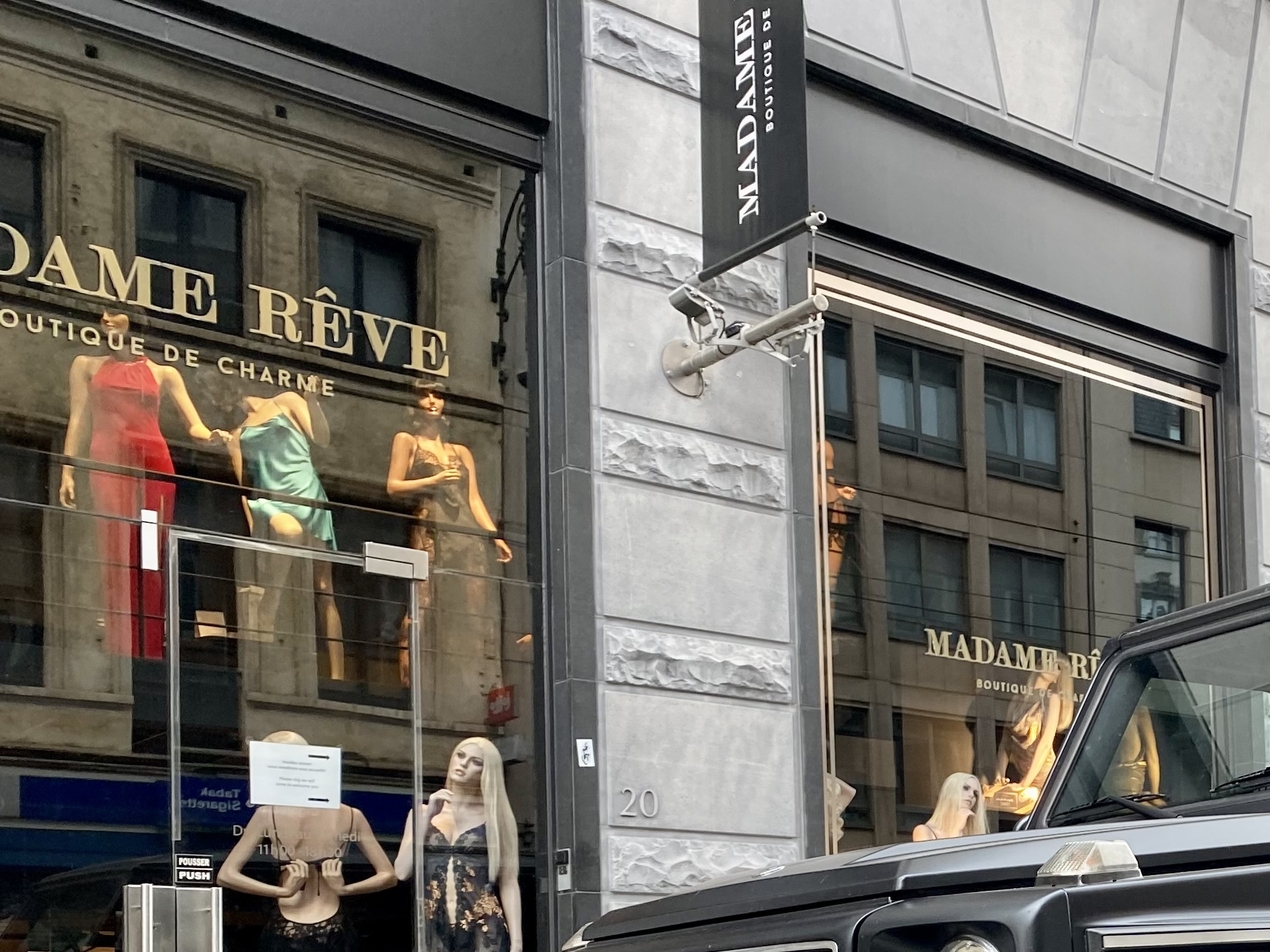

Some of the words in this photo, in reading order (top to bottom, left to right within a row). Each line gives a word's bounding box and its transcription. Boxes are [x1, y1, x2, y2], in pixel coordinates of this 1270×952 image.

[762, 7, 772, 32] DE
[762, 38, 775, 132] BOUTIQUE
[734, 8, 759, 224] MADAME
[248, 284, 449, 377] RÊVE
[0, 308, 145, 356] OUTIQUE
[164, 344, 200, 368] DE
[217, 356, 335, 397] CHARME
[923, 628, 1062, 676] MADAME
[619, 787, 659, 818] 20
[232, 824, 246, 837] D
[178, 857, 210, 868] POUSSER
[178, 870, 211, 881] PUSH
